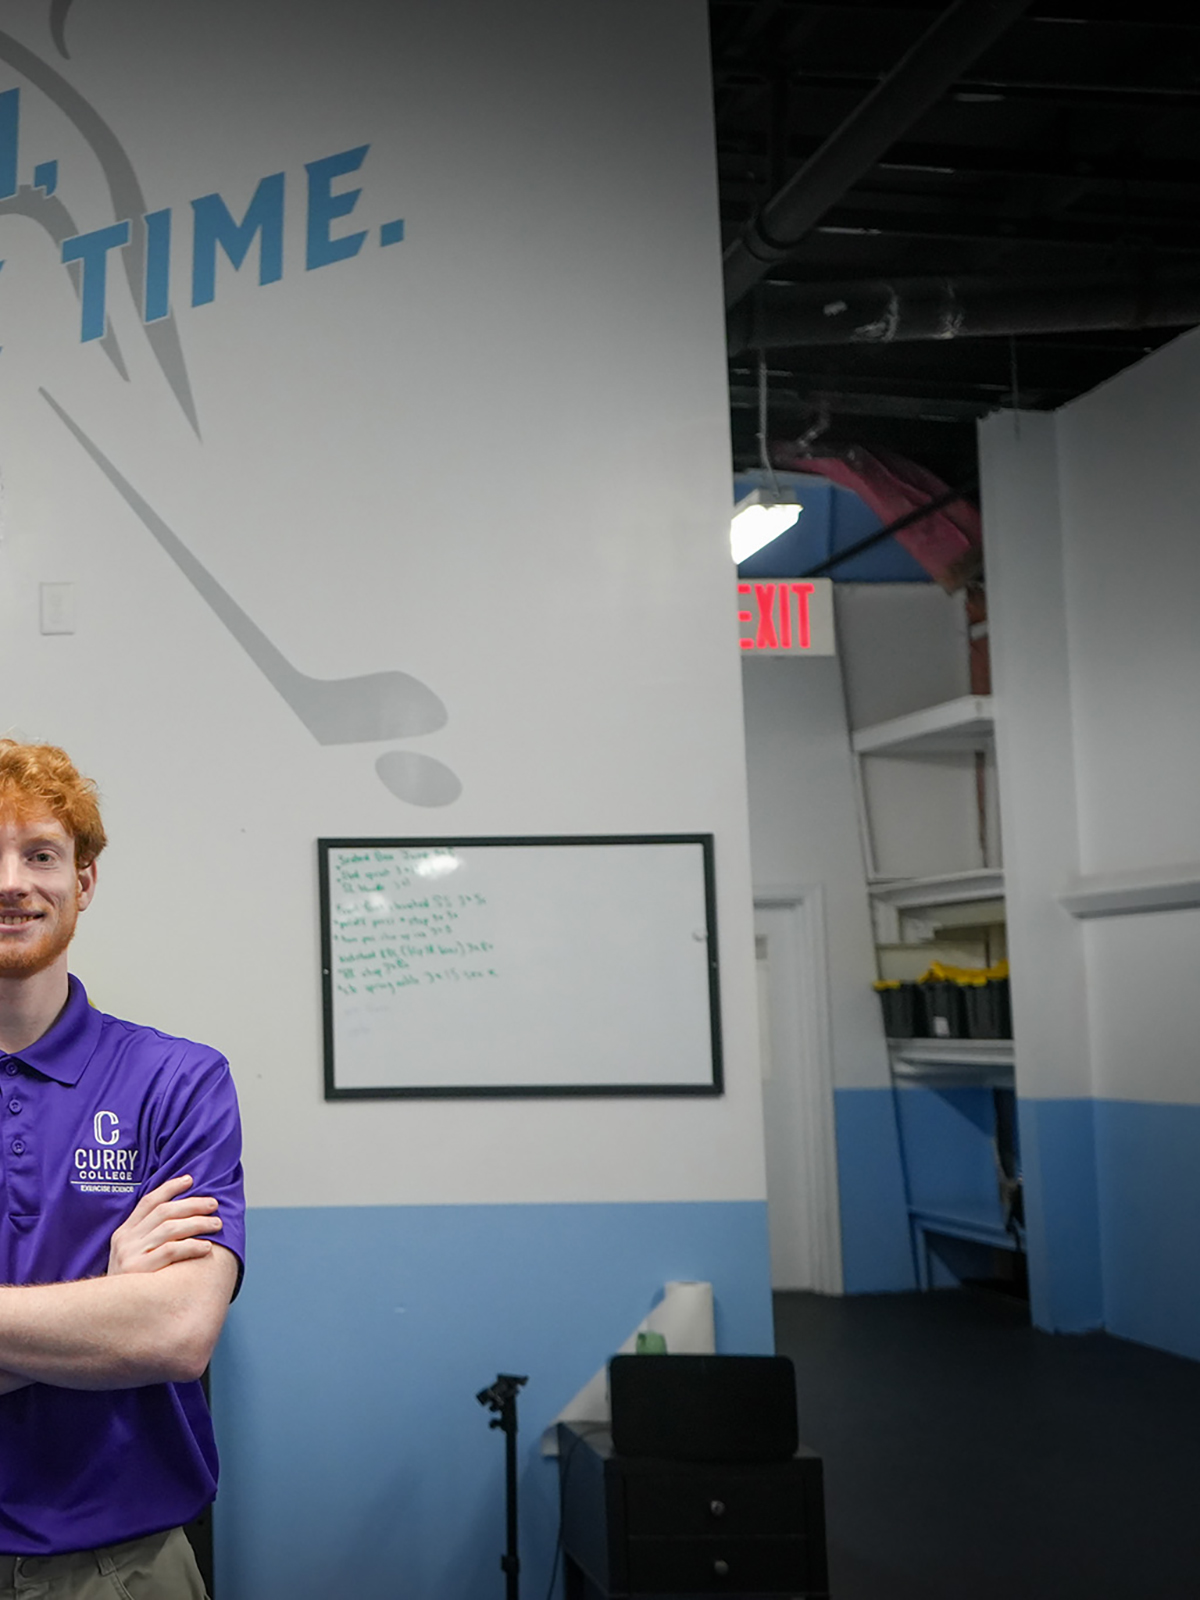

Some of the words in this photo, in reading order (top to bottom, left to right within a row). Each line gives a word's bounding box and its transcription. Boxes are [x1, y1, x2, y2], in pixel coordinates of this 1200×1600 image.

[60, 143, 405, 344] TIME.
[737, 582, 815, 650] EXIT
[74, 1148, 139, 1171] CURRY
[79, 1170, 133, 1181] COLLEGE
